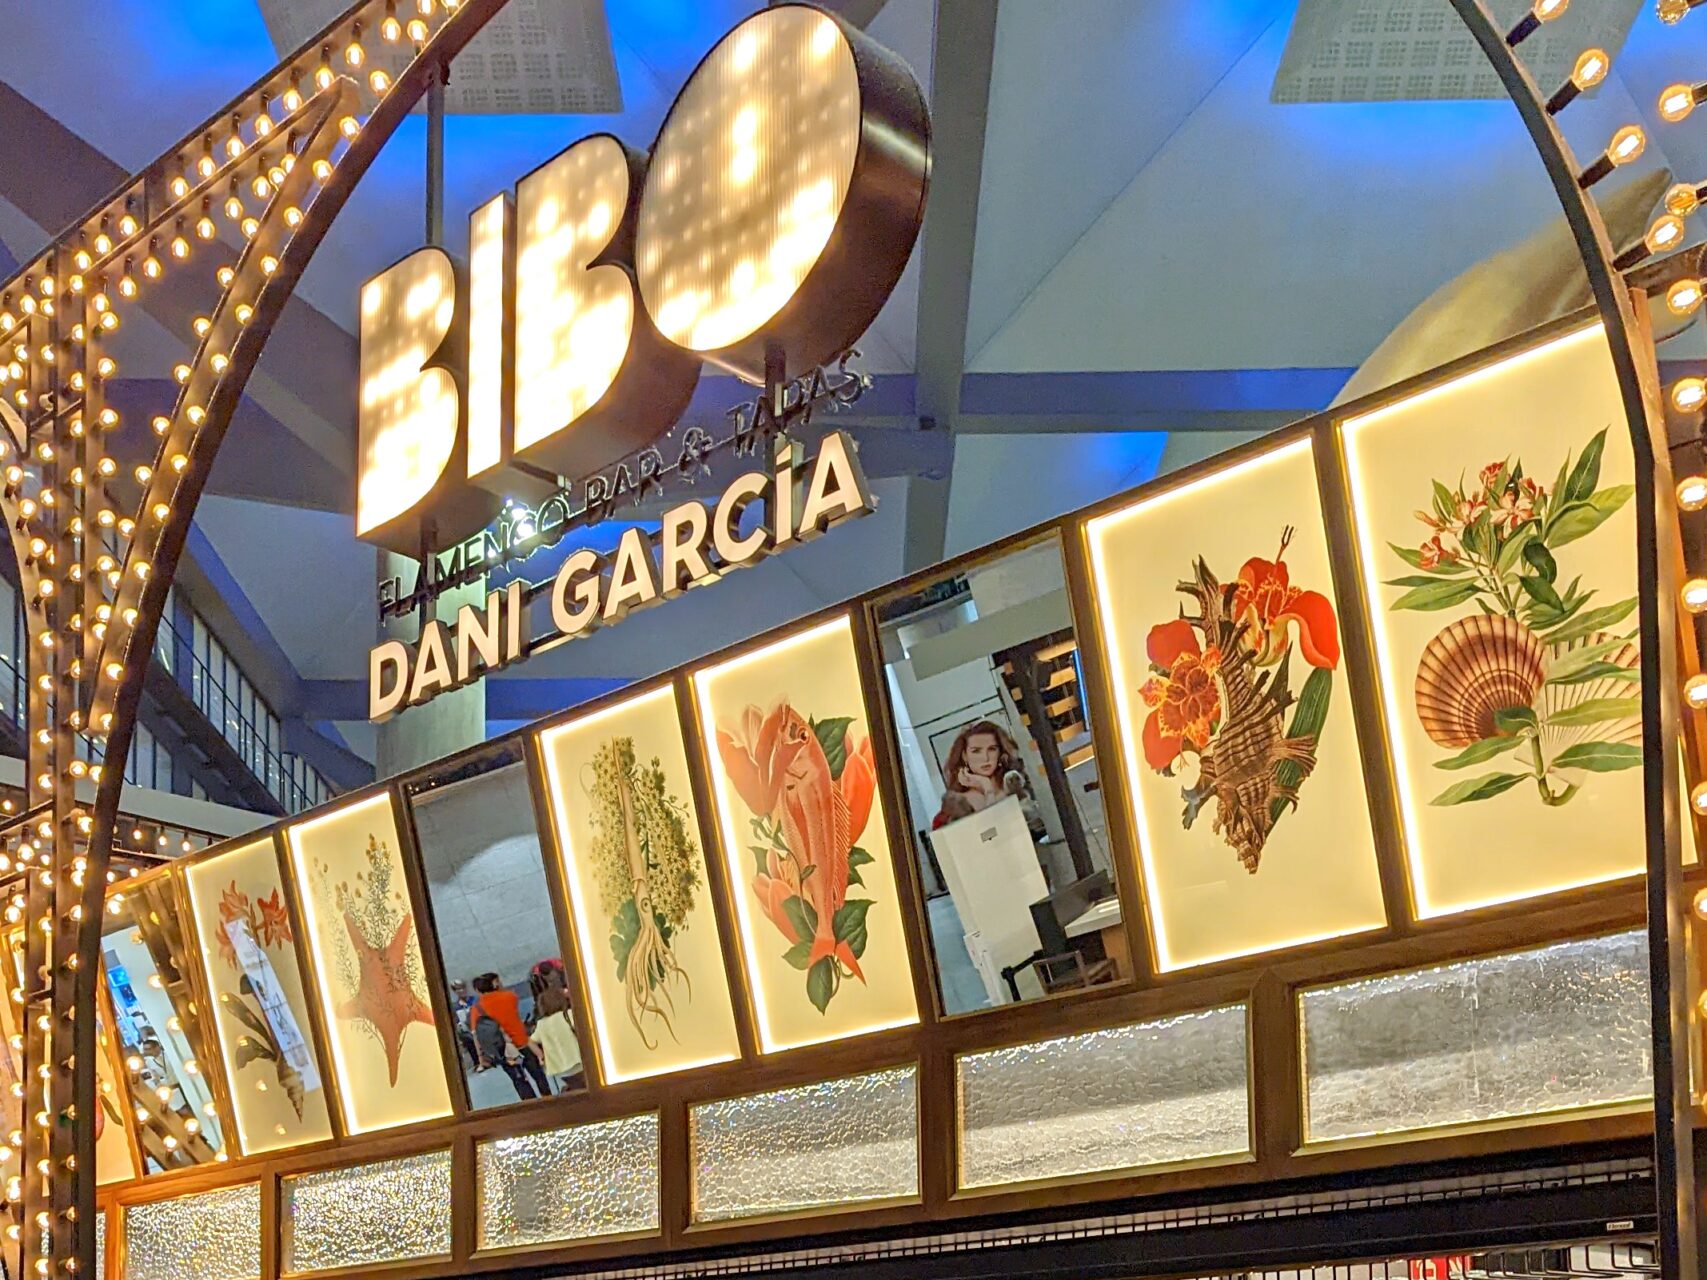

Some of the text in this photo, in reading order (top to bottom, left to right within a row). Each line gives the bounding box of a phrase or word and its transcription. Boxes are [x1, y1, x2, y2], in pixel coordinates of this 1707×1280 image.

[356, 3, 862, 538] BIBO
[368, 431, 868, 721] DANI GARCÍA
